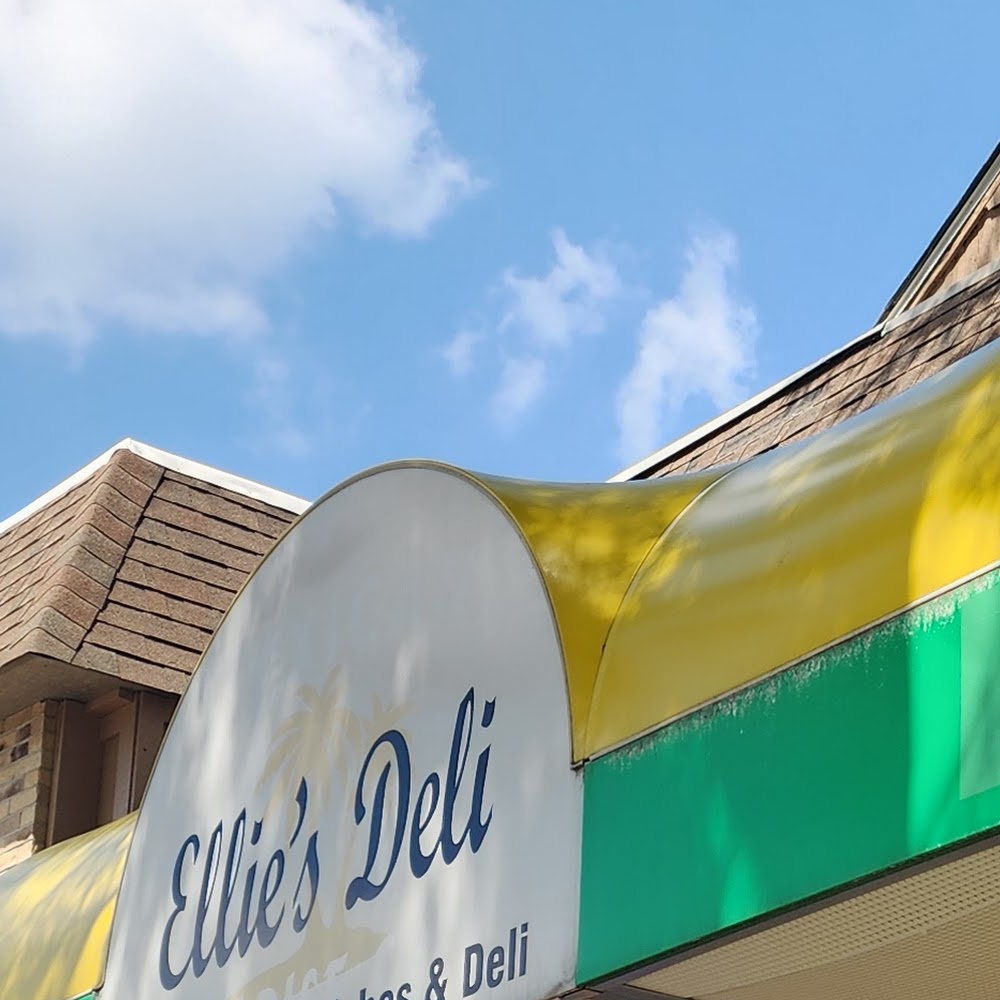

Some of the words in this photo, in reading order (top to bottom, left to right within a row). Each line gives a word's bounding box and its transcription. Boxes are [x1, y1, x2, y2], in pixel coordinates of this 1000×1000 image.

[159, 776, 319, 990] Ellie's
[345, 686, 497, 909] Deli
[462, 922, 530, 998] Deli
